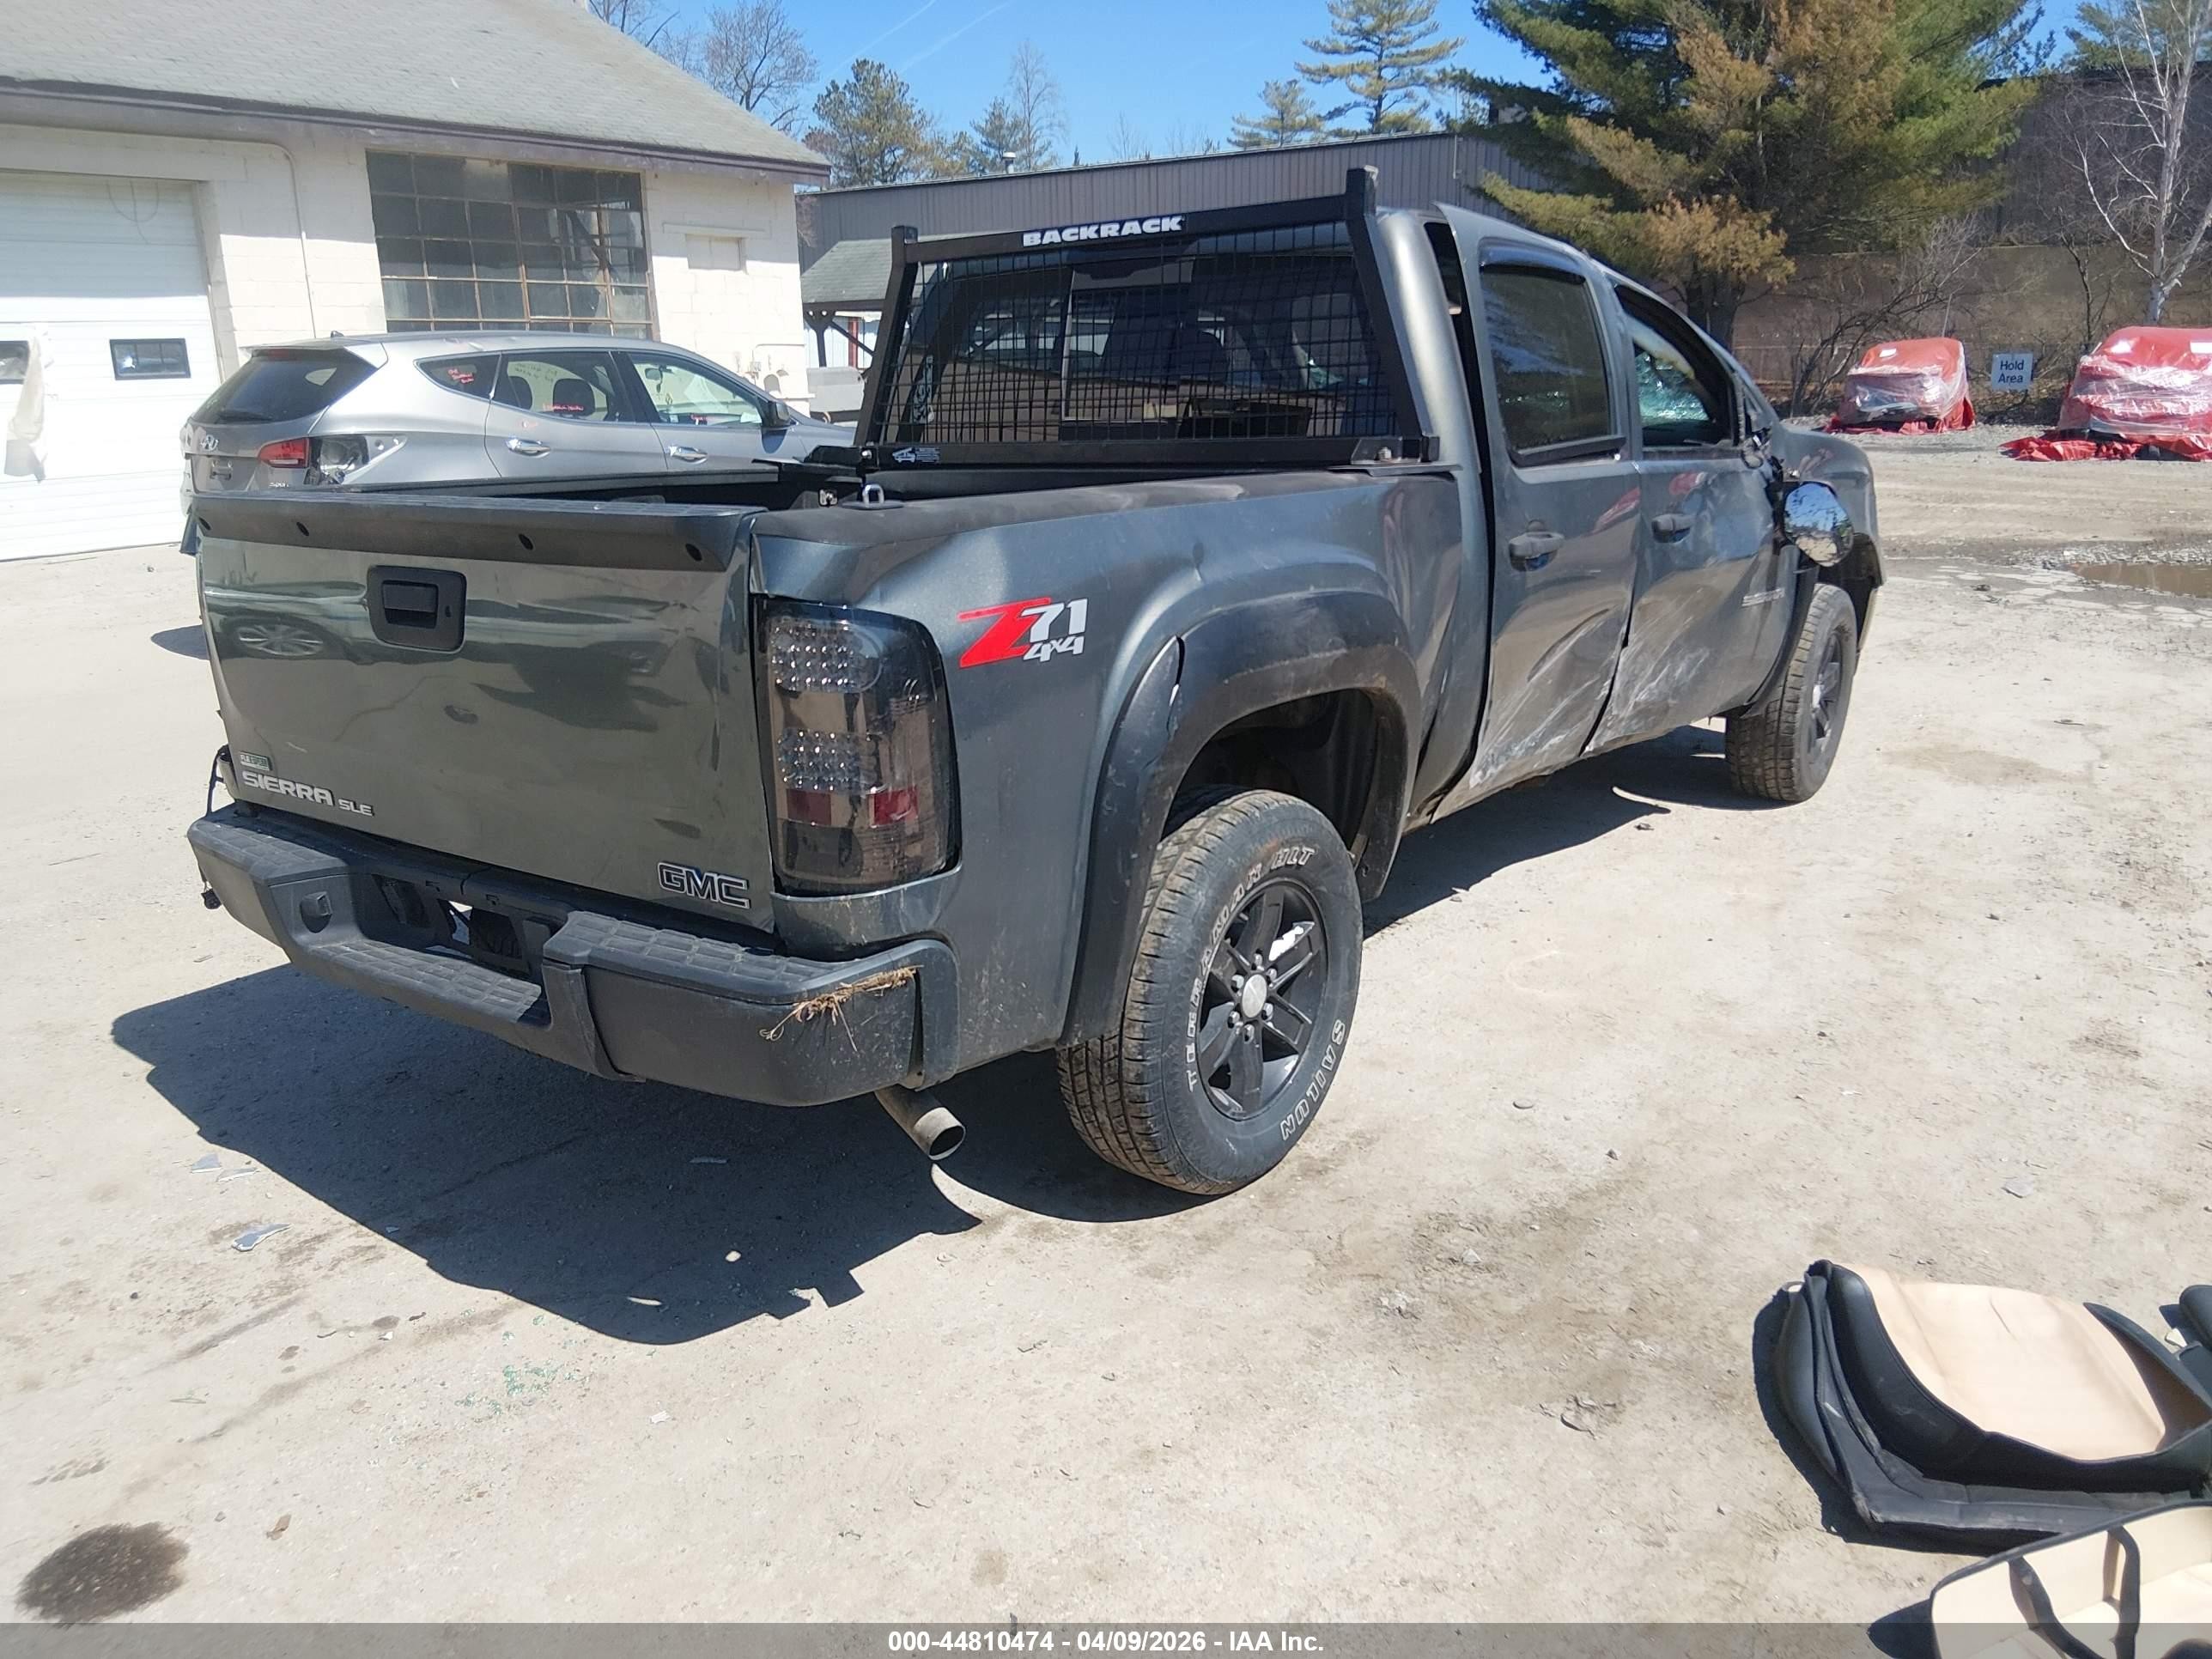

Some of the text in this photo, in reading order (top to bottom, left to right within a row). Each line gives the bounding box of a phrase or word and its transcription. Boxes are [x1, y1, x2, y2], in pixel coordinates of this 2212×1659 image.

[1023, 216, 1182, 246] BACKRACK
[1998, 373, 2023, 383] Area
[2000, 359, 2025, 370] Hold
[957, 598, 1088, 668] Z71
[242, 770, 374, 817] SIERRA SLE
[657, 861, 751, 909] GMC
[1279, 1019, 1346, 1142] SAILUN
